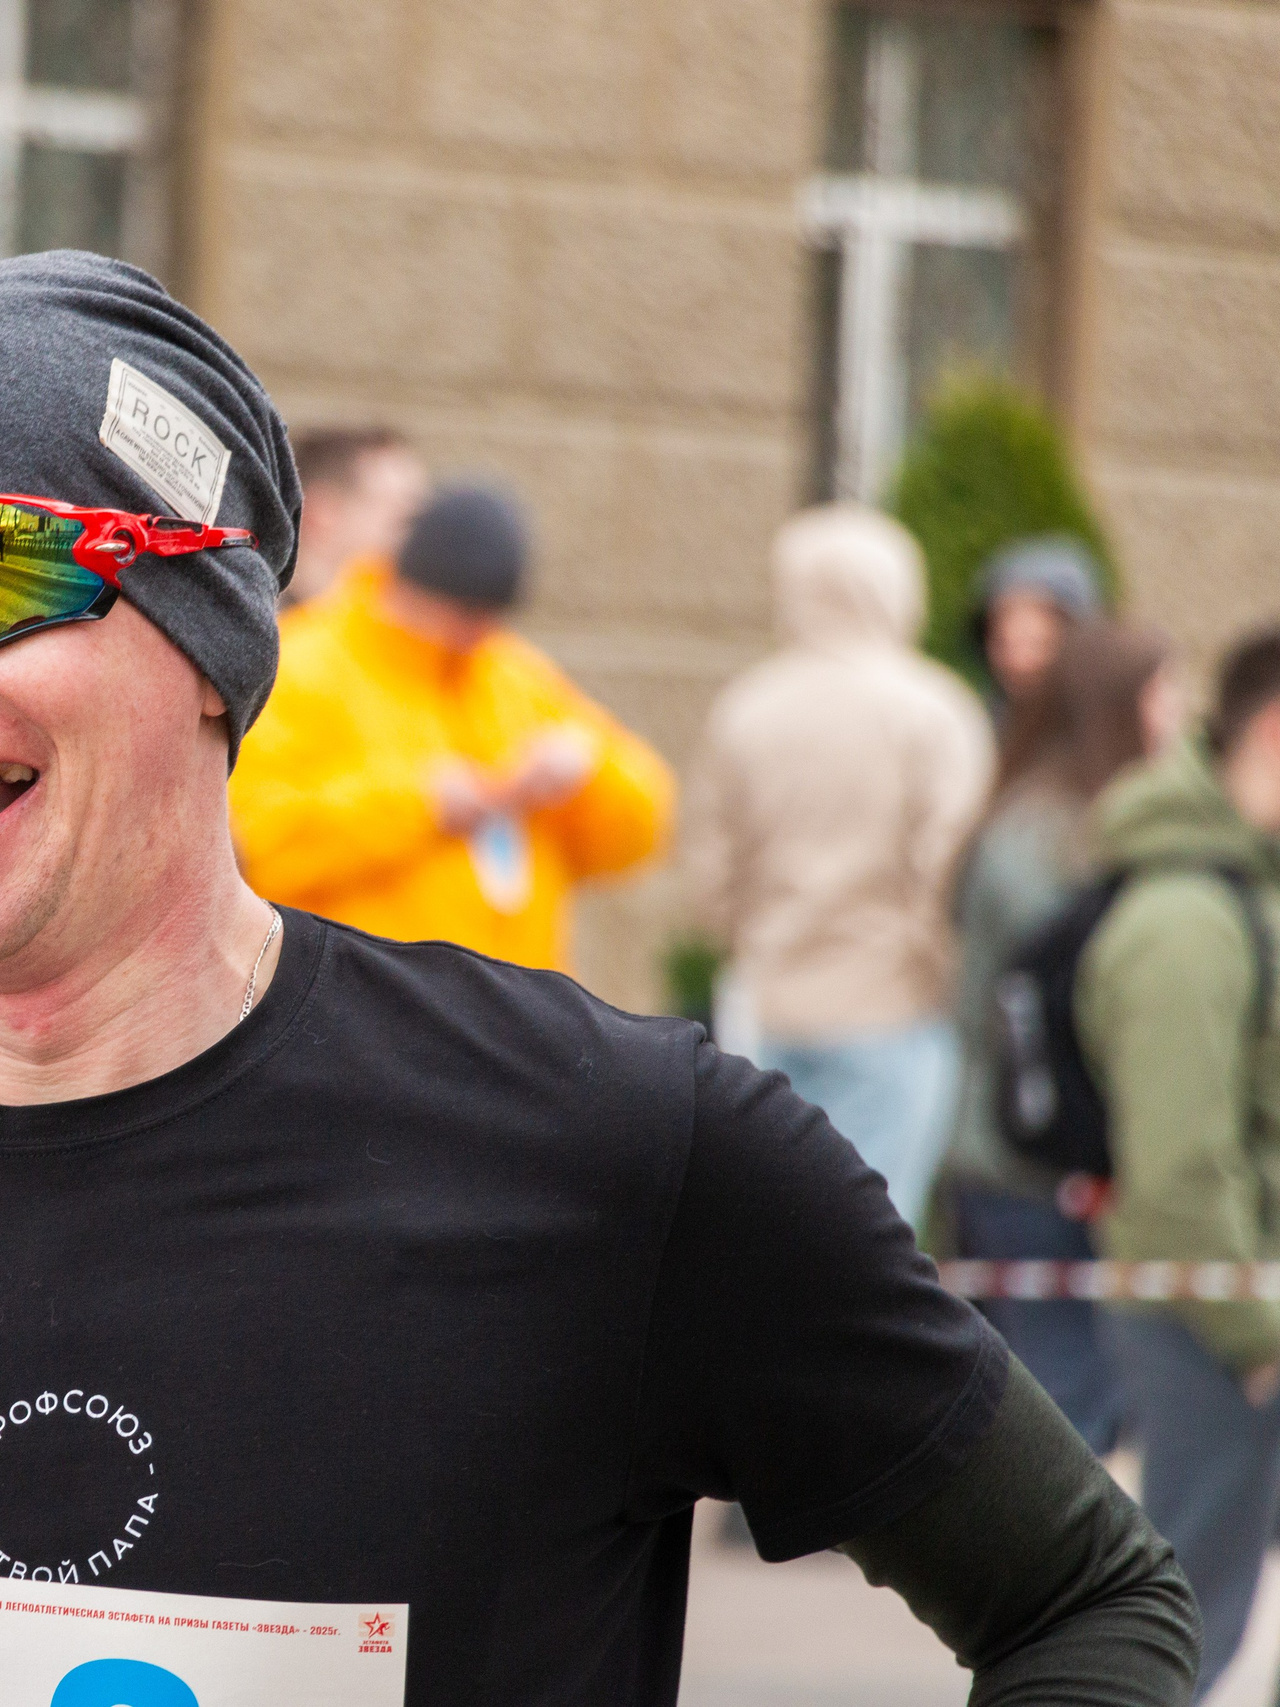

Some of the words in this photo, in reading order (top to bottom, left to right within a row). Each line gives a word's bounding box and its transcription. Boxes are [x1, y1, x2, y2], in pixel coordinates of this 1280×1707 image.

[131, 397, 207, 478] ROCK
[87, 1492, 159, 1577] ПАПА
[5, 1602, 106, 1619] ЛЕГКОАТЛЕТИЧЕСКАЯ
[108, 1611, 155, 1625] ЭСТАФЕТА
[158, 1616, 171, 1626] НА
[173, 1617, 209, 1629] ПРИЗЫ
[211, 1620, 250, 1632] ГАЗЕТЫ
[252, 1623, 301, 1636] «ЗВЕЗДА»
[310, 1625, 341, 1636] 2025г.
[357, 1645, 393, 1653] ЗВЕЗДА
